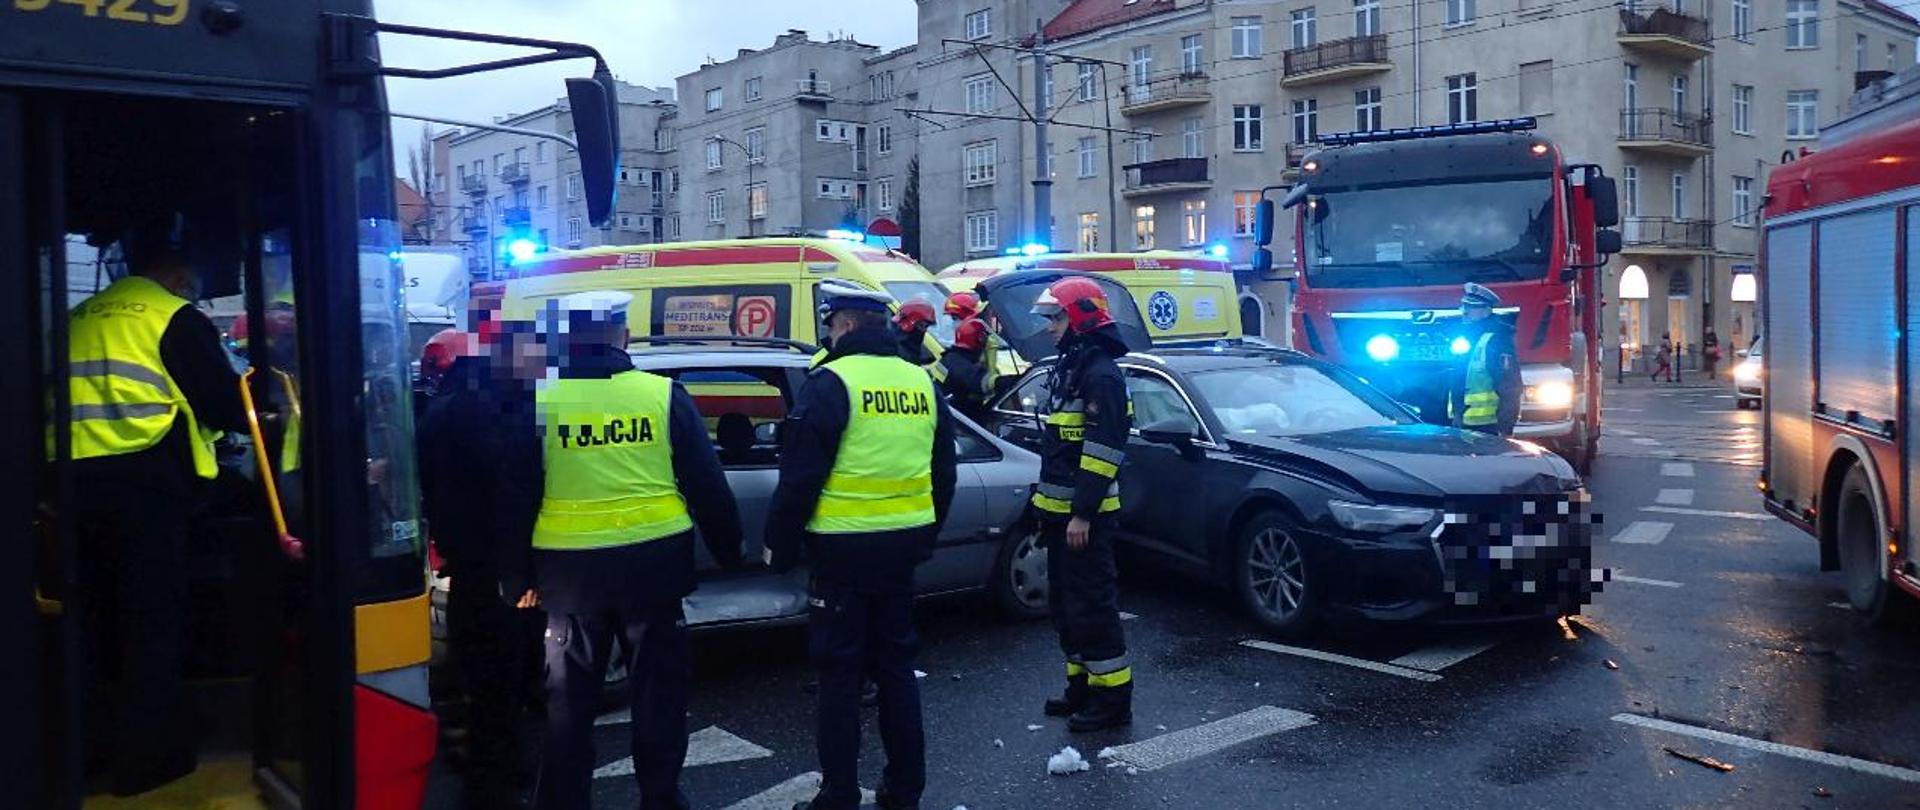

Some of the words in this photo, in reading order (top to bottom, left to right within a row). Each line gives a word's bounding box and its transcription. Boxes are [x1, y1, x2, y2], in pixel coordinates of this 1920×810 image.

[14, 0, 189, 25] 429
[665, 312, 729, 321] MEDITRANS
[862, 390, 930, 415] POLICJA
